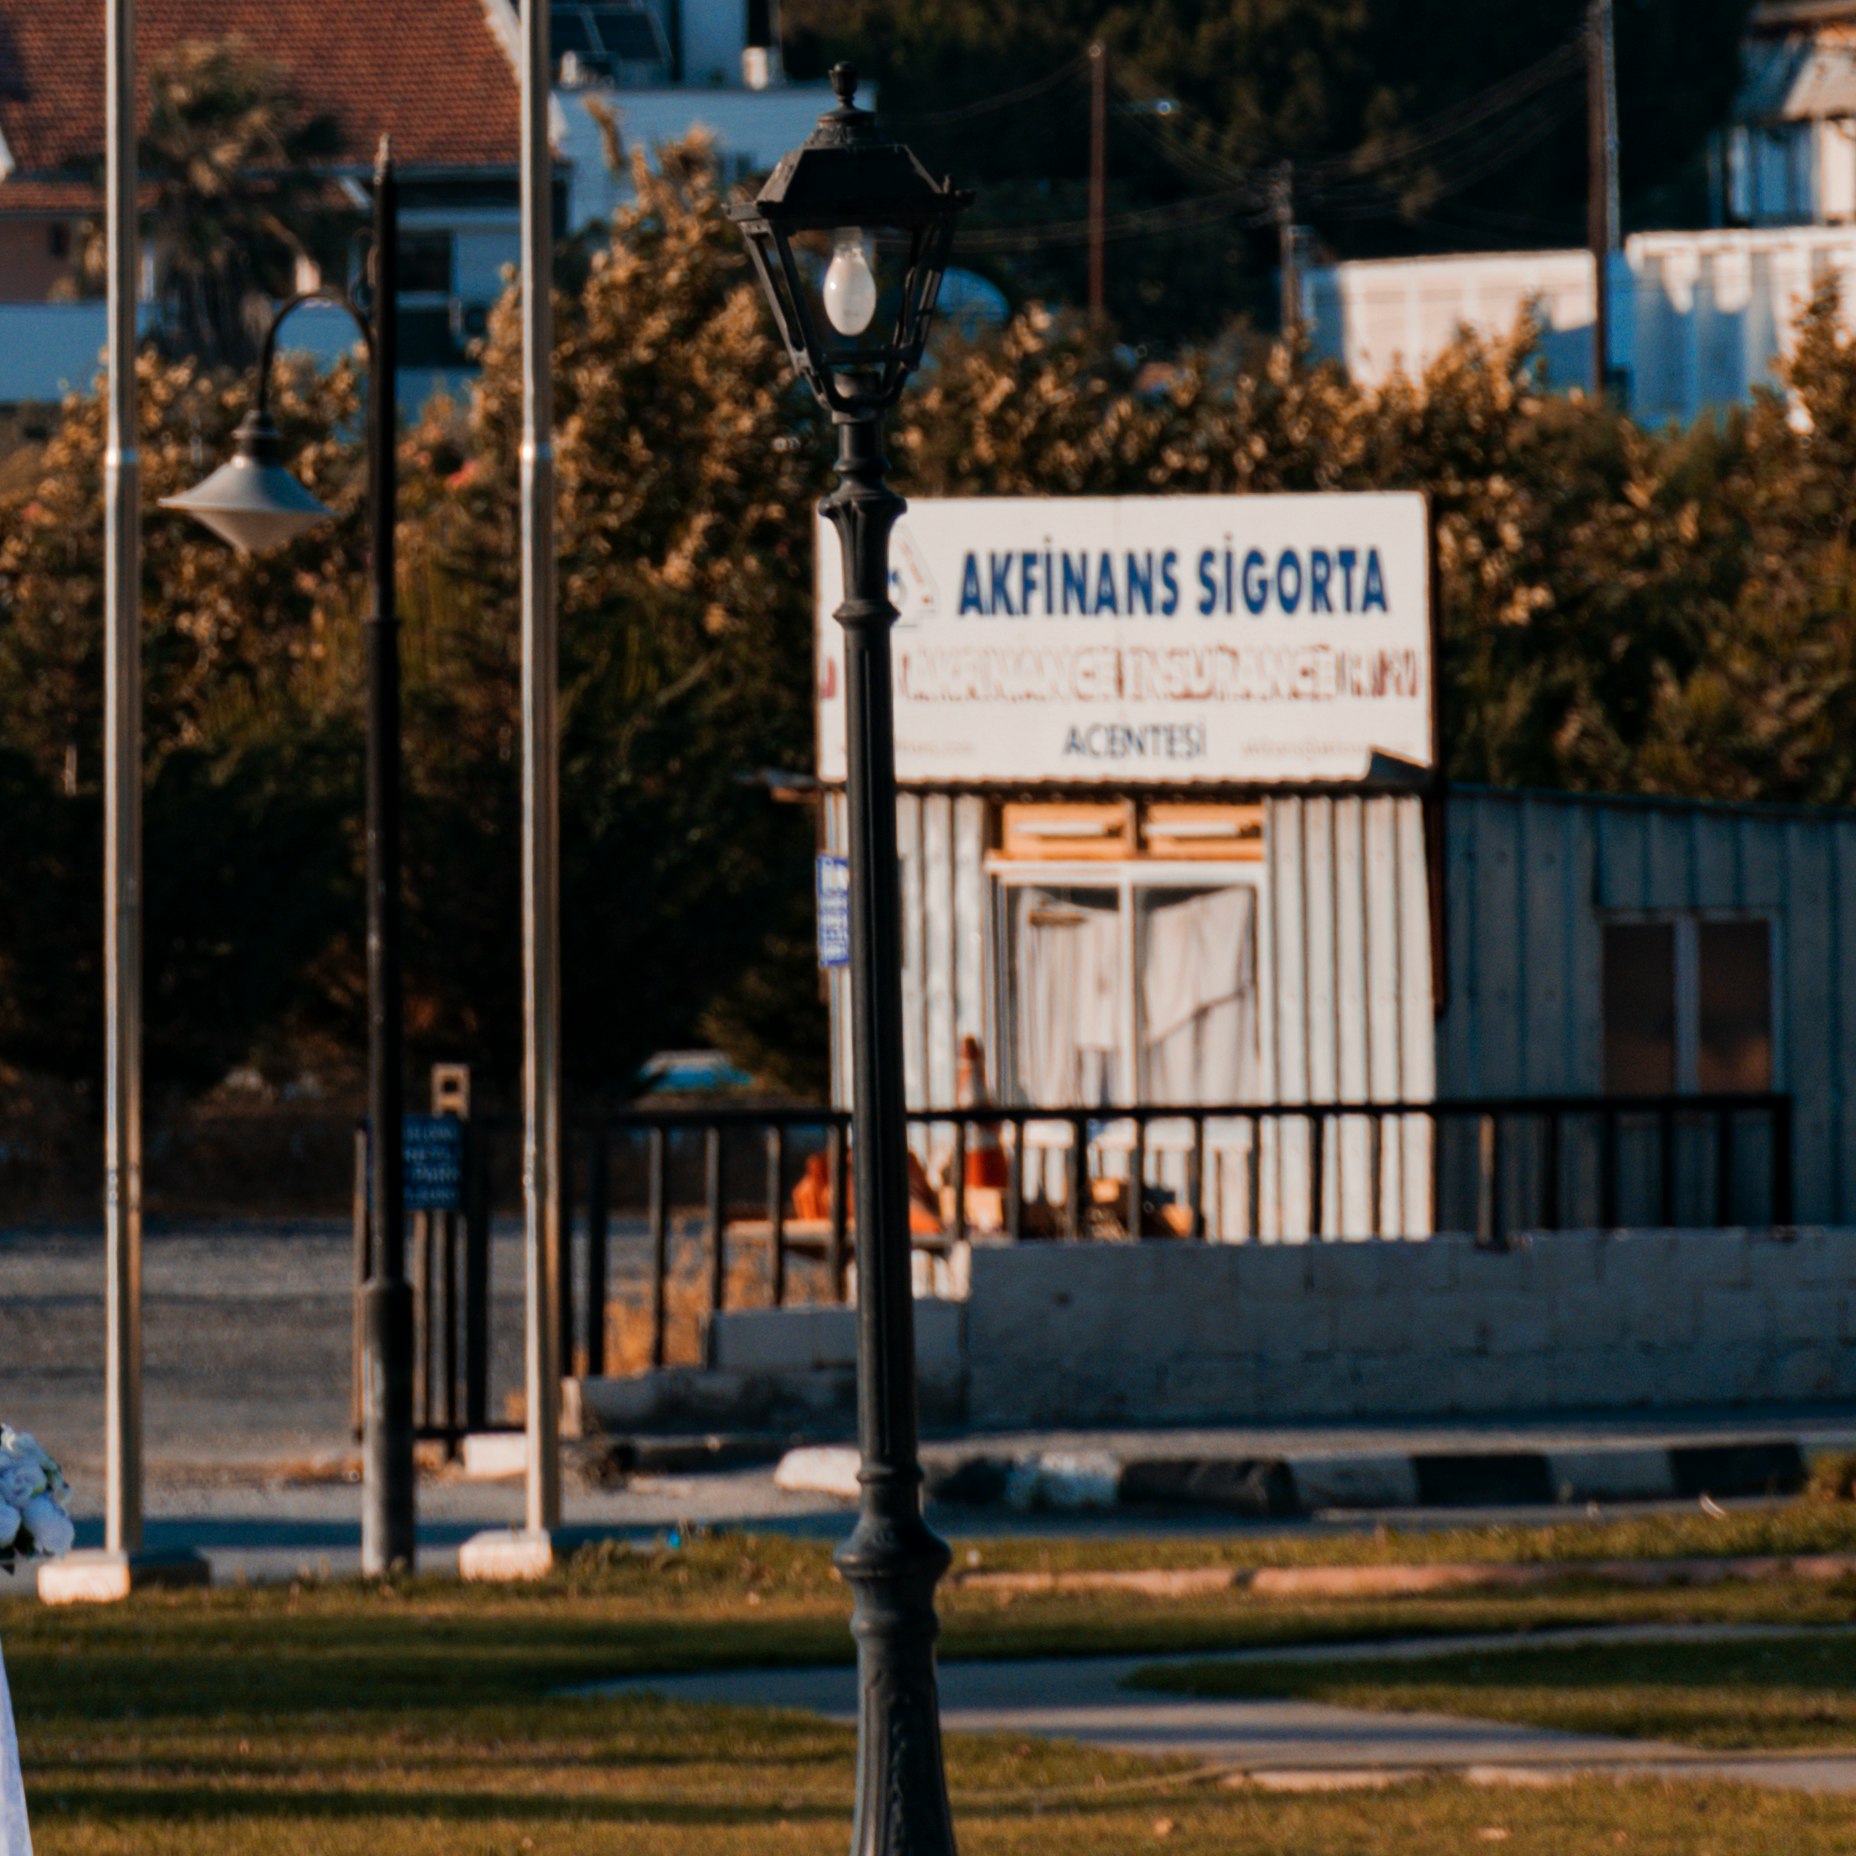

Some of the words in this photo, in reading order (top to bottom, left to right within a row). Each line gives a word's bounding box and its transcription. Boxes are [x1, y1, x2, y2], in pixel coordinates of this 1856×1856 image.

[956, 532, 1181, 617] AKFİNANS
[1196, 531, 1389, 616] SİGORTA
[1061, 720, 1208, 760] ACENTESİ
